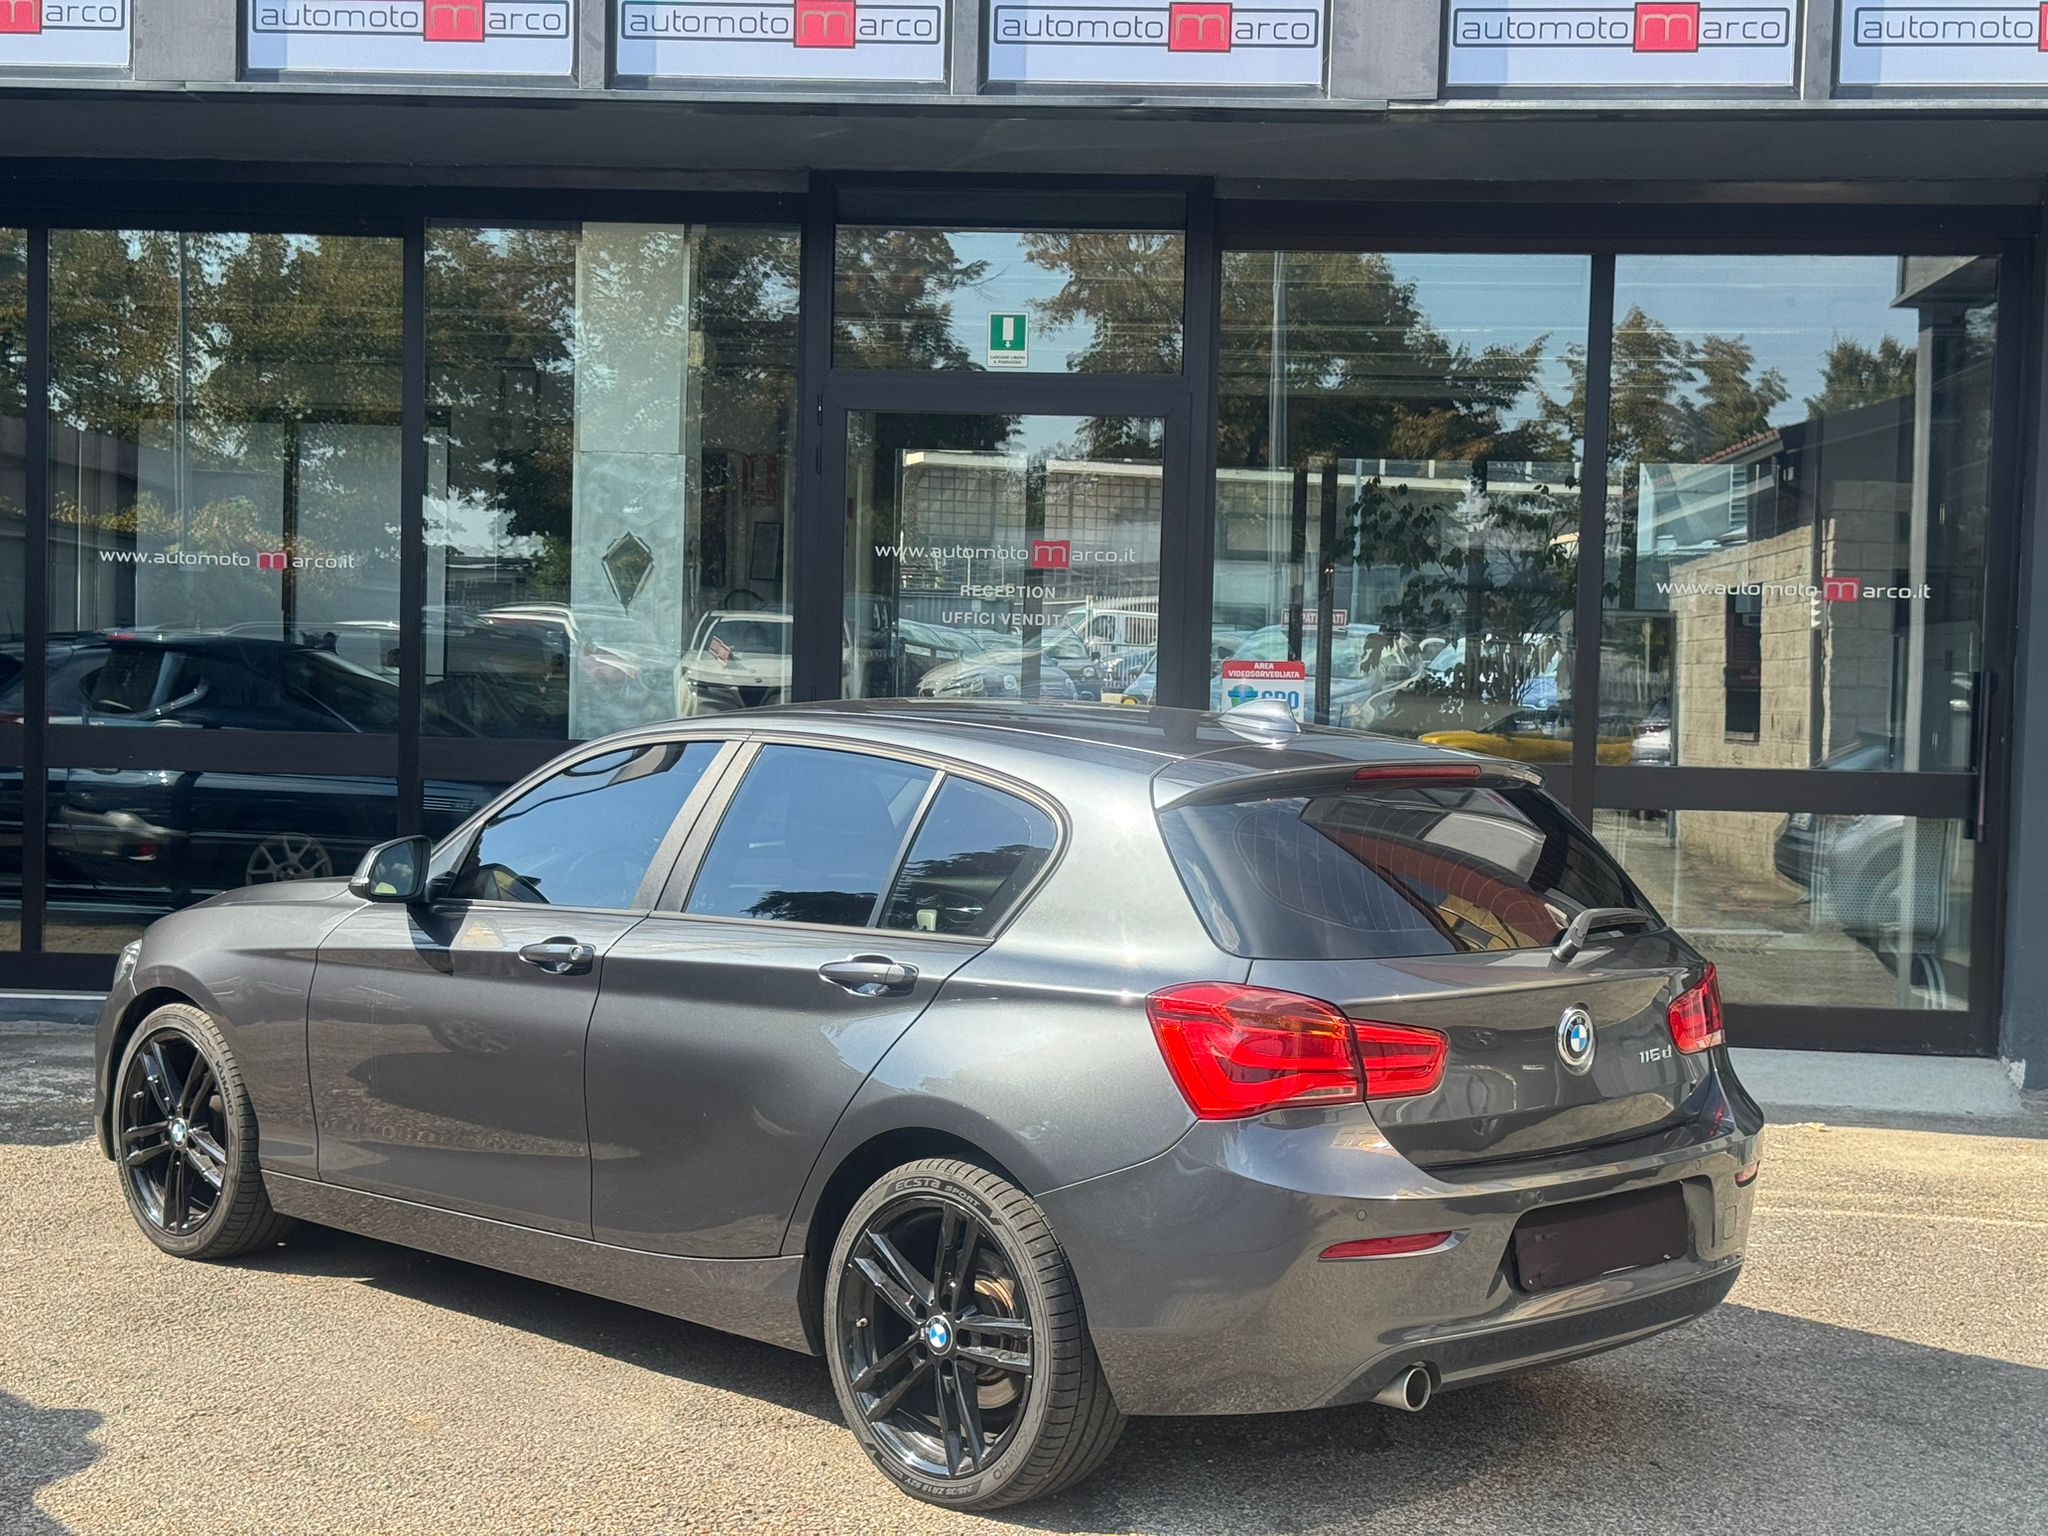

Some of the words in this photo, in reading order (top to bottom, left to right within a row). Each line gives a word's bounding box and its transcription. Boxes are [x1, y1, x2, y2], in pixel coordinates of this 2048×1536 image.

[260, 4, 418, 29] automoto
[629, 9, 788, 36] automoto
[1001, 12, 1163, 39] automoto
[1461, 15, 1628, 40] automoto
[1863, 15, 2034, 39] automoto
[960, 585, 1056, 598] RECEPTION
[942, 611, 995, 625] UFFICI
[1000, 612, 1071, 626] VENDITA
[1228, 670, 1300, 678] VIDEOSORVEGLIATA
[1254, 662, 1274, 670] AREA
[1639, 1044, 1672, 1064] 116d
[944, 1185, 981, 1207] SPORT
